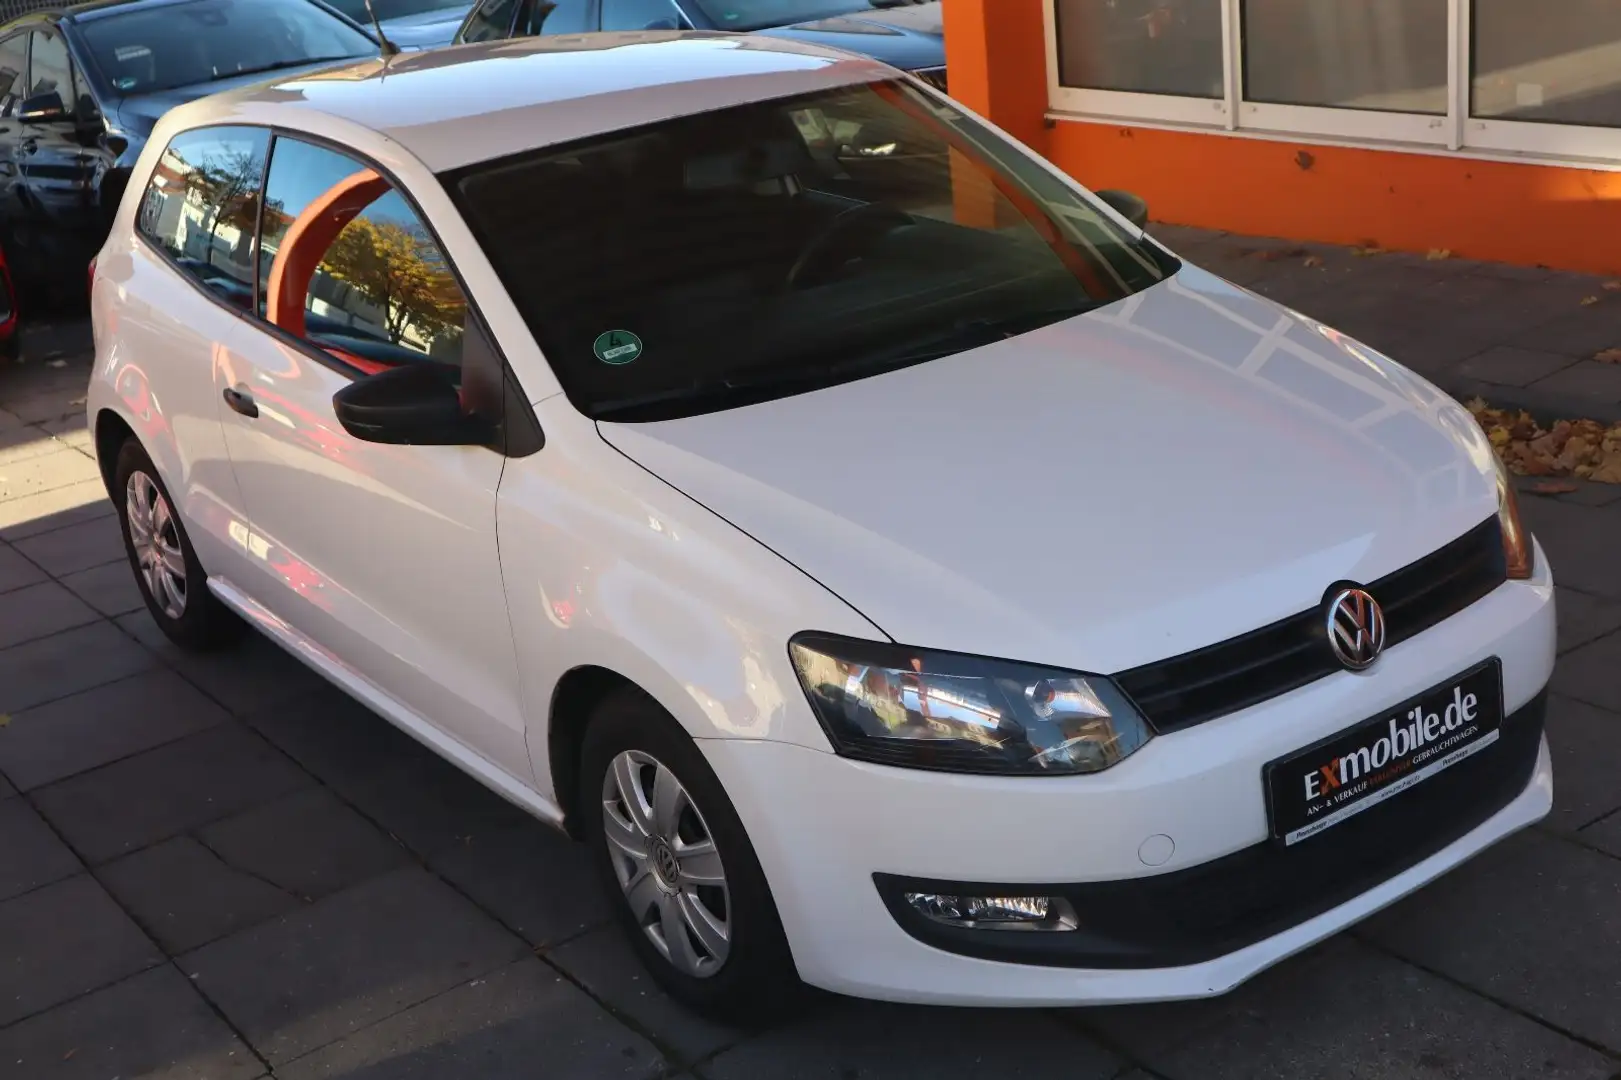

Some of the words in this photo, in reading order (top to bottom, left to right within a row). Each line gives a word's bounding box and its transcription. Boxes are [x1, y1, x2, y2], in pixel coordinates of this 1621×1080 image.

[1304, 686, 1477, 800] EXmobile.de
[1326, 799, 1332, 807] &
[1334, 781, 1368, 803] VERKAUF
[1412, 725, 1478, 764] GEBRAUCHTWAGEN
